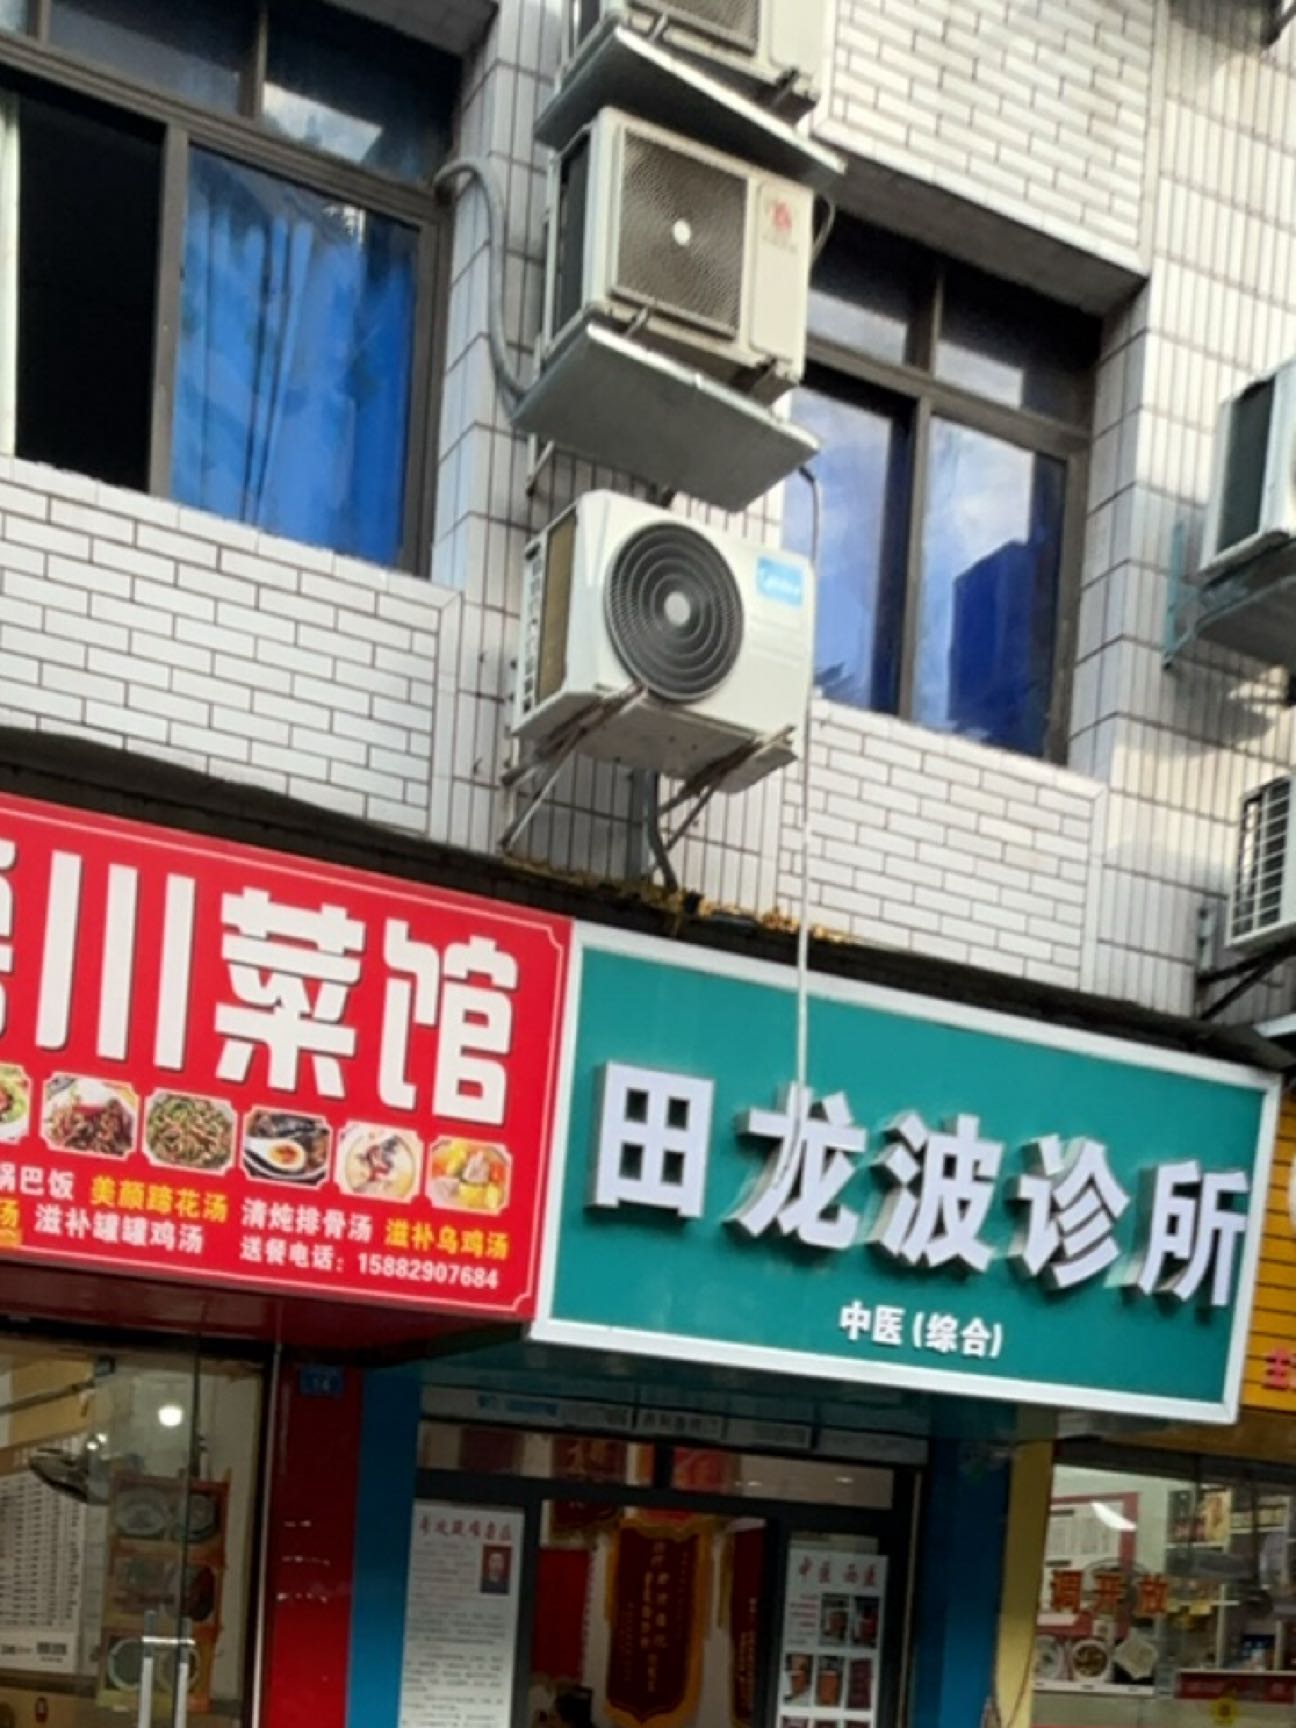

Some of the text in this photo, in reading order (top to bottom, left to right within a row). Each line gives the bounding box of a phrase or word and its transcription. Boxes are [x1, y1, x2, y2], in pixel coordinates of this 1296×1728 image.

[589, 1060, 1249, 1307] 田龙波诊所
